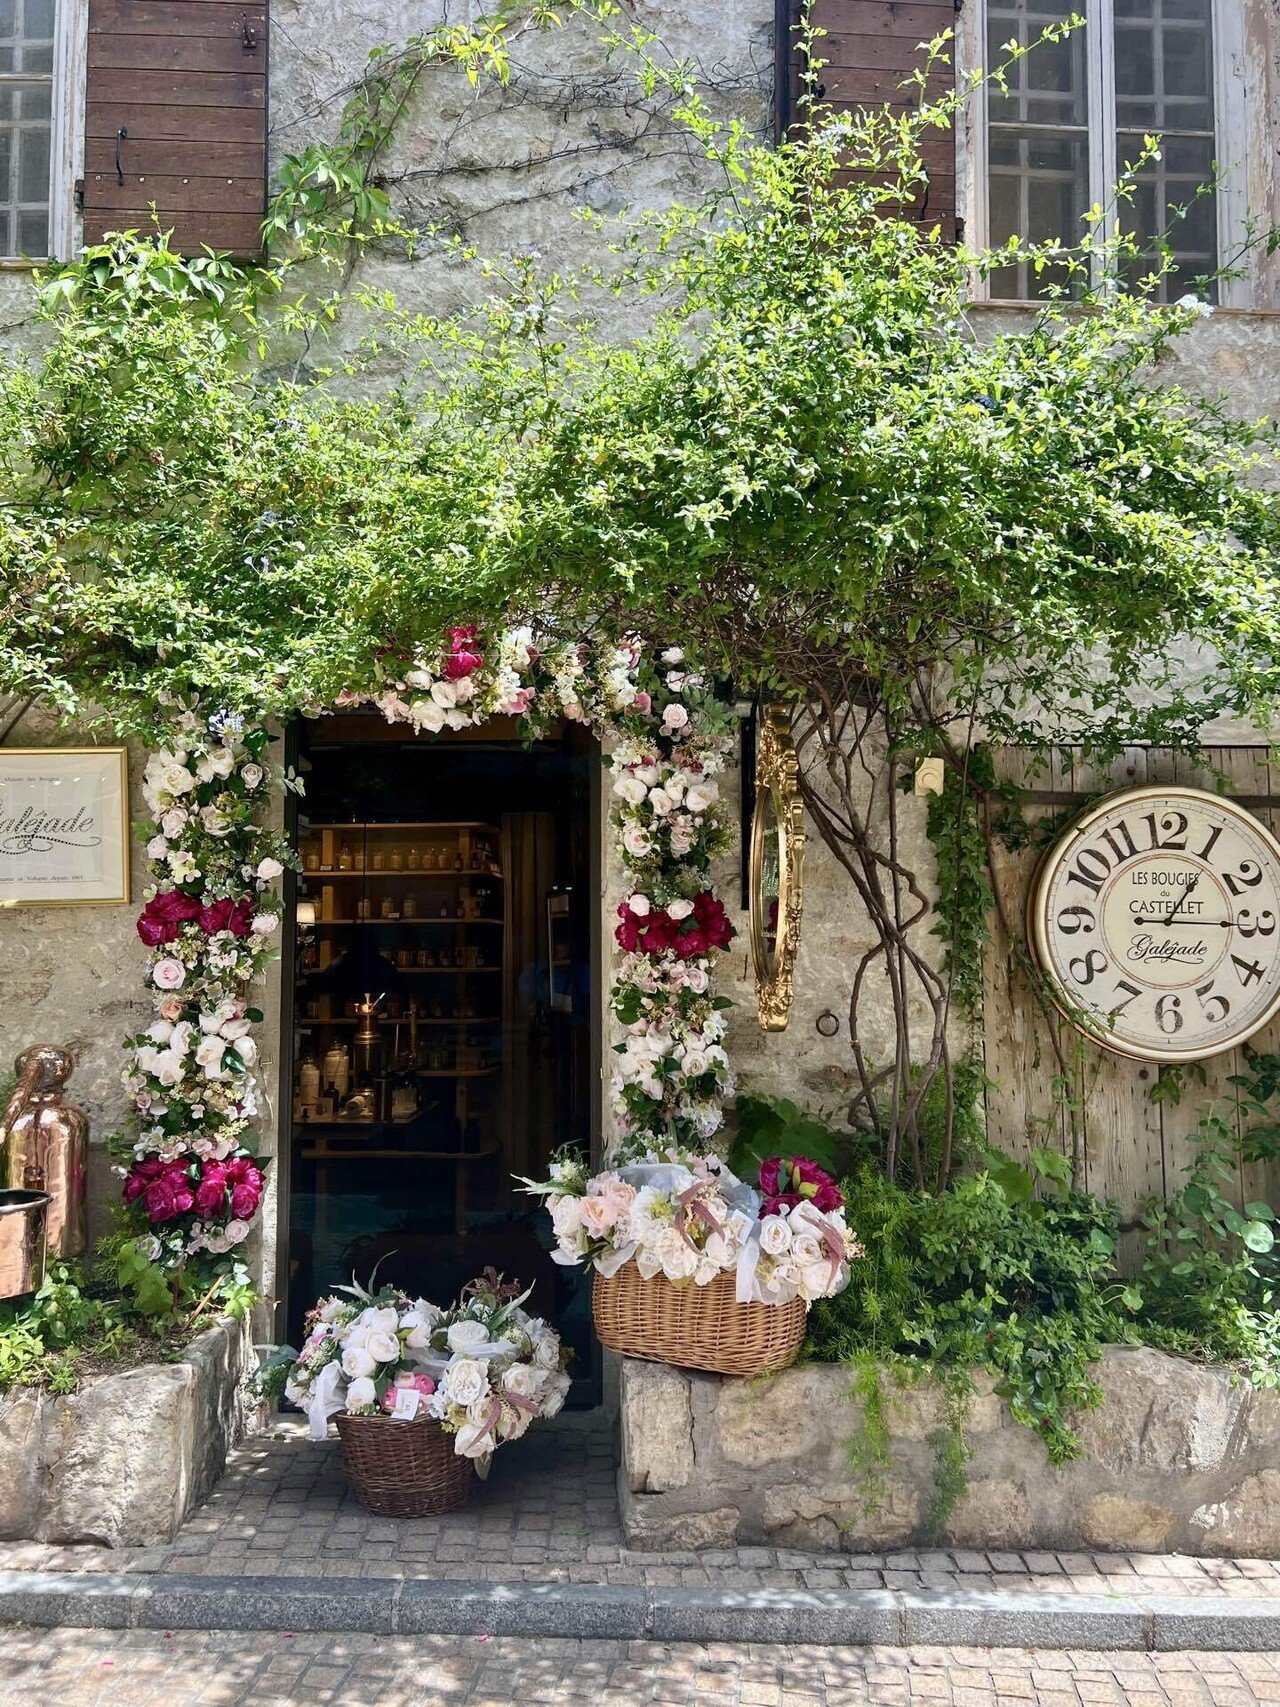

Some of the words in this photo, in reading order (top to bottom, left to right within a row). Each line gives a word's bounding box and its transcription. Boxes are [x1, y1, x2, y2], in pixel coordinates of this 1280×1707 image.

[0, 799, 101, 854] aléjade
[1097, 820, 1145, 868] 11
[1141, 812, 1189, 850] 12
[1191, 823, 1223, 865] 1
[1066, 849, 1111, 902] 10
[1132, 872, 1148, 885] LES
[1152, 872, 1199, 886] BOUGIES
[1222, 860, 1263, 896] 2
[1057, 906, 1096, 935] 9
[1129, 900, 1204, 914] CASTELLET
[1237, 909, 1276, 938] 3
[1127, 933, 1208, 964] Galéjade
[1069, 950, 1109, 986] 8
[1230, 953, 1267, 988] 4
[1108, 980, 1144, 1016] 7
[1155, 994, 1184, 1034] 6
[1196, 980, 1230, 1023] 5
